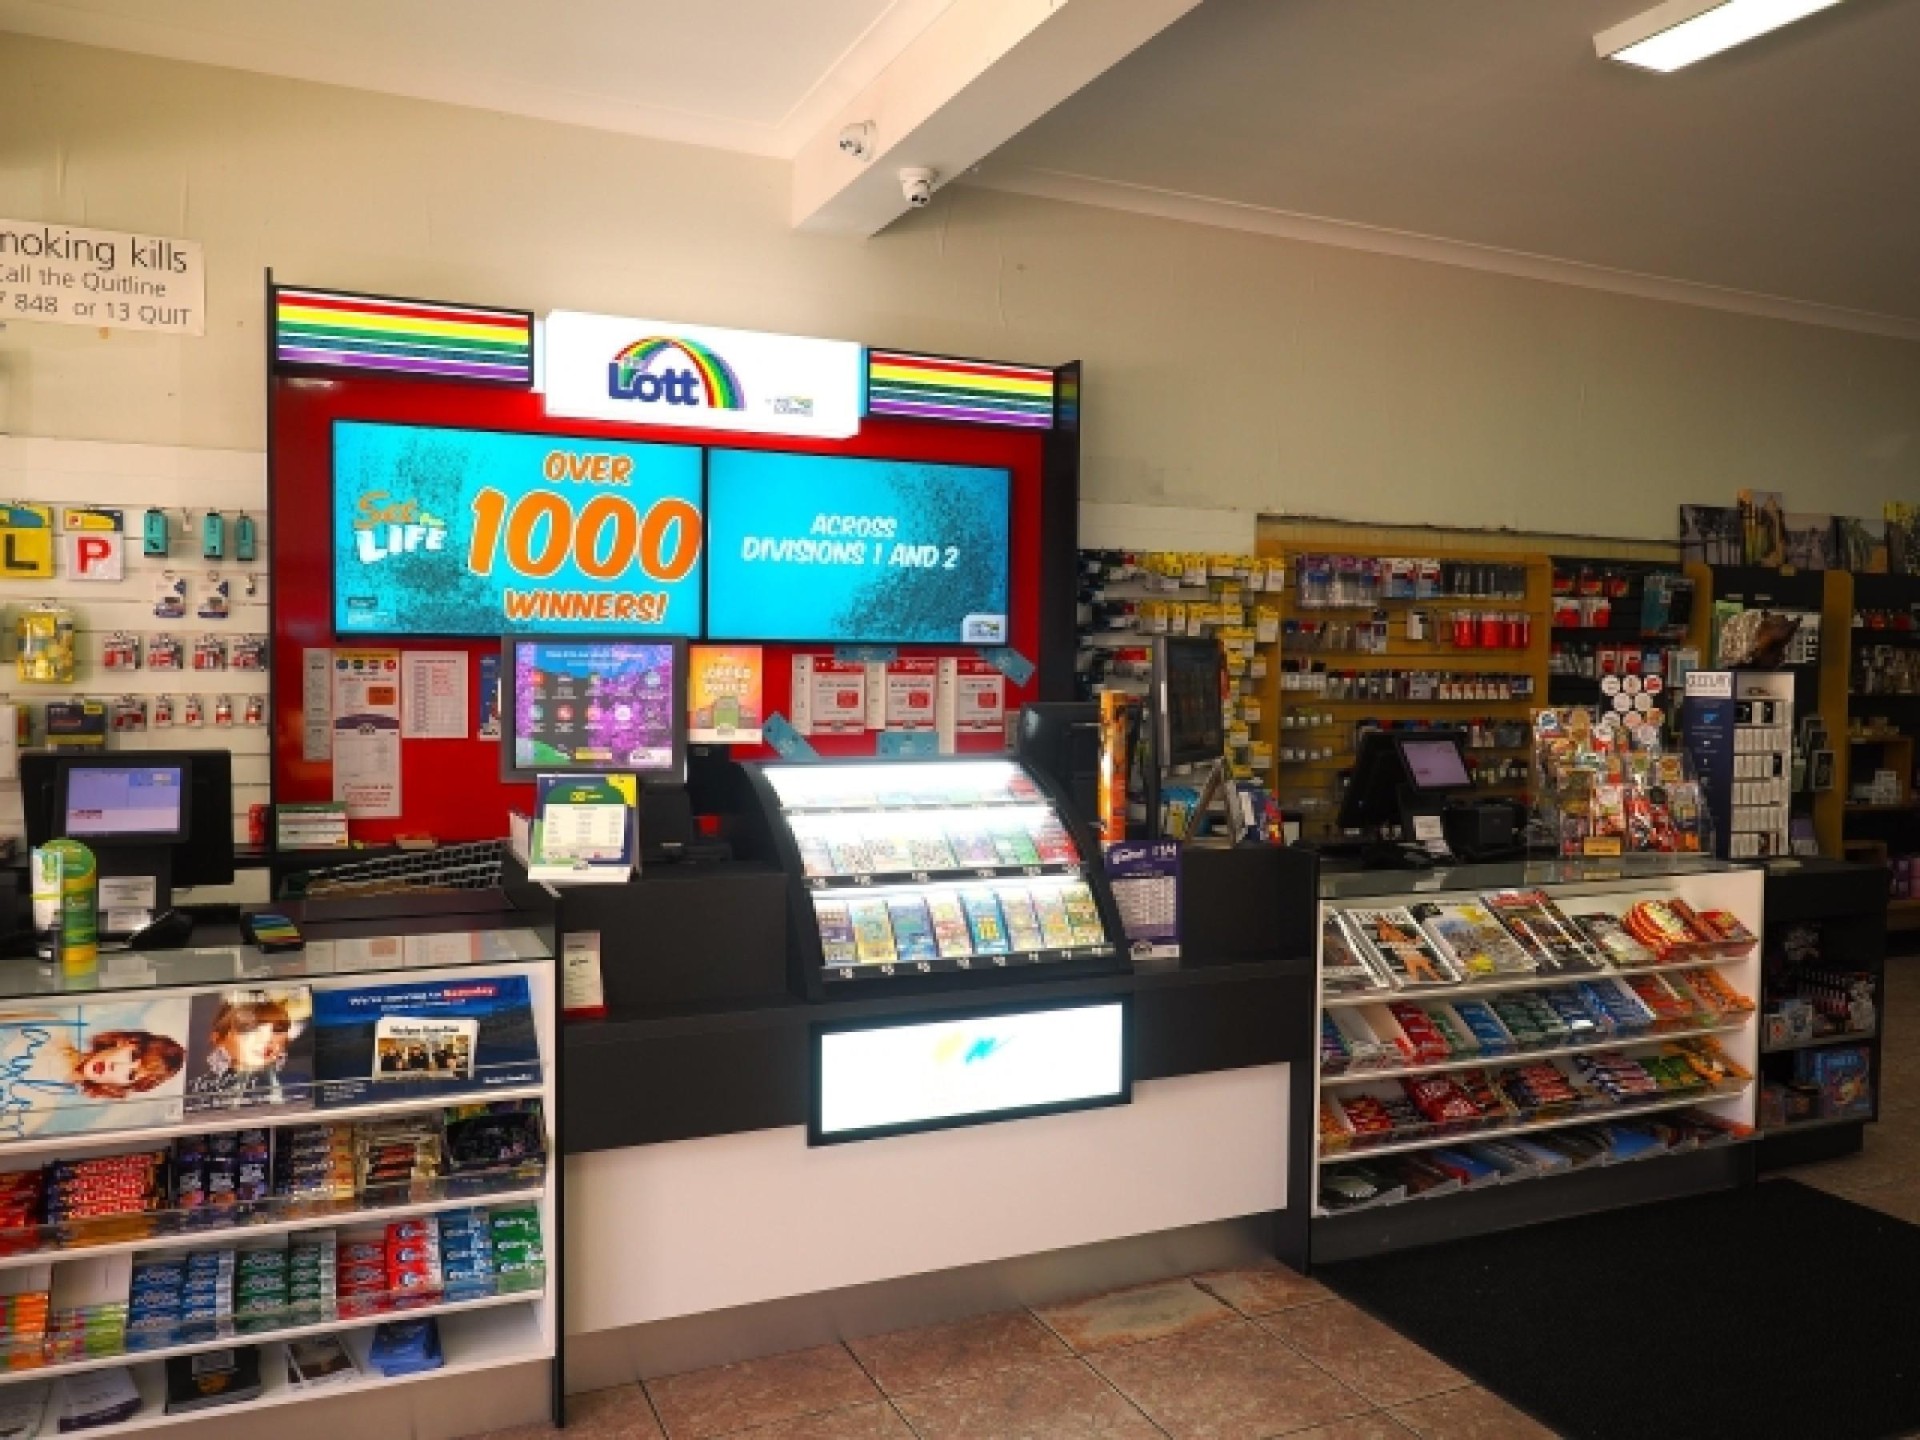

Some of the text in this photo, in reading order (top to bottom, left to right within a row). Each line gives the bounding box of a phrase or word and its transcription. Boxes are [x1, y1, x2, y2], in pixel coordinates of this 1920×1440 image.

[131, 236, 187, 274] kills
[39, 267, 75, 288] the
[82, 271, 166, 297] Quitline
[72, 303, 97, 318] or
[105, 302, 130, 321] 13
[138, 304, 192, 325] QUIT
[607, 361, 700, 406] Lott
[543, 450, 634, 486] OVER
[467, 486, 703, 583] 1000
[810, 513, 898, 538] ACROSS
[5, 533, 39, 570] L
[77, 536, 112, 574] P
[355, 523, 449, 566] LIFE
[741, 535, 865, 565] DIVISIONS
[887, 542, 940, 568] AND
[942, 545, 961, 569] 2
[503, 587, 668, 624] WINNERS!
